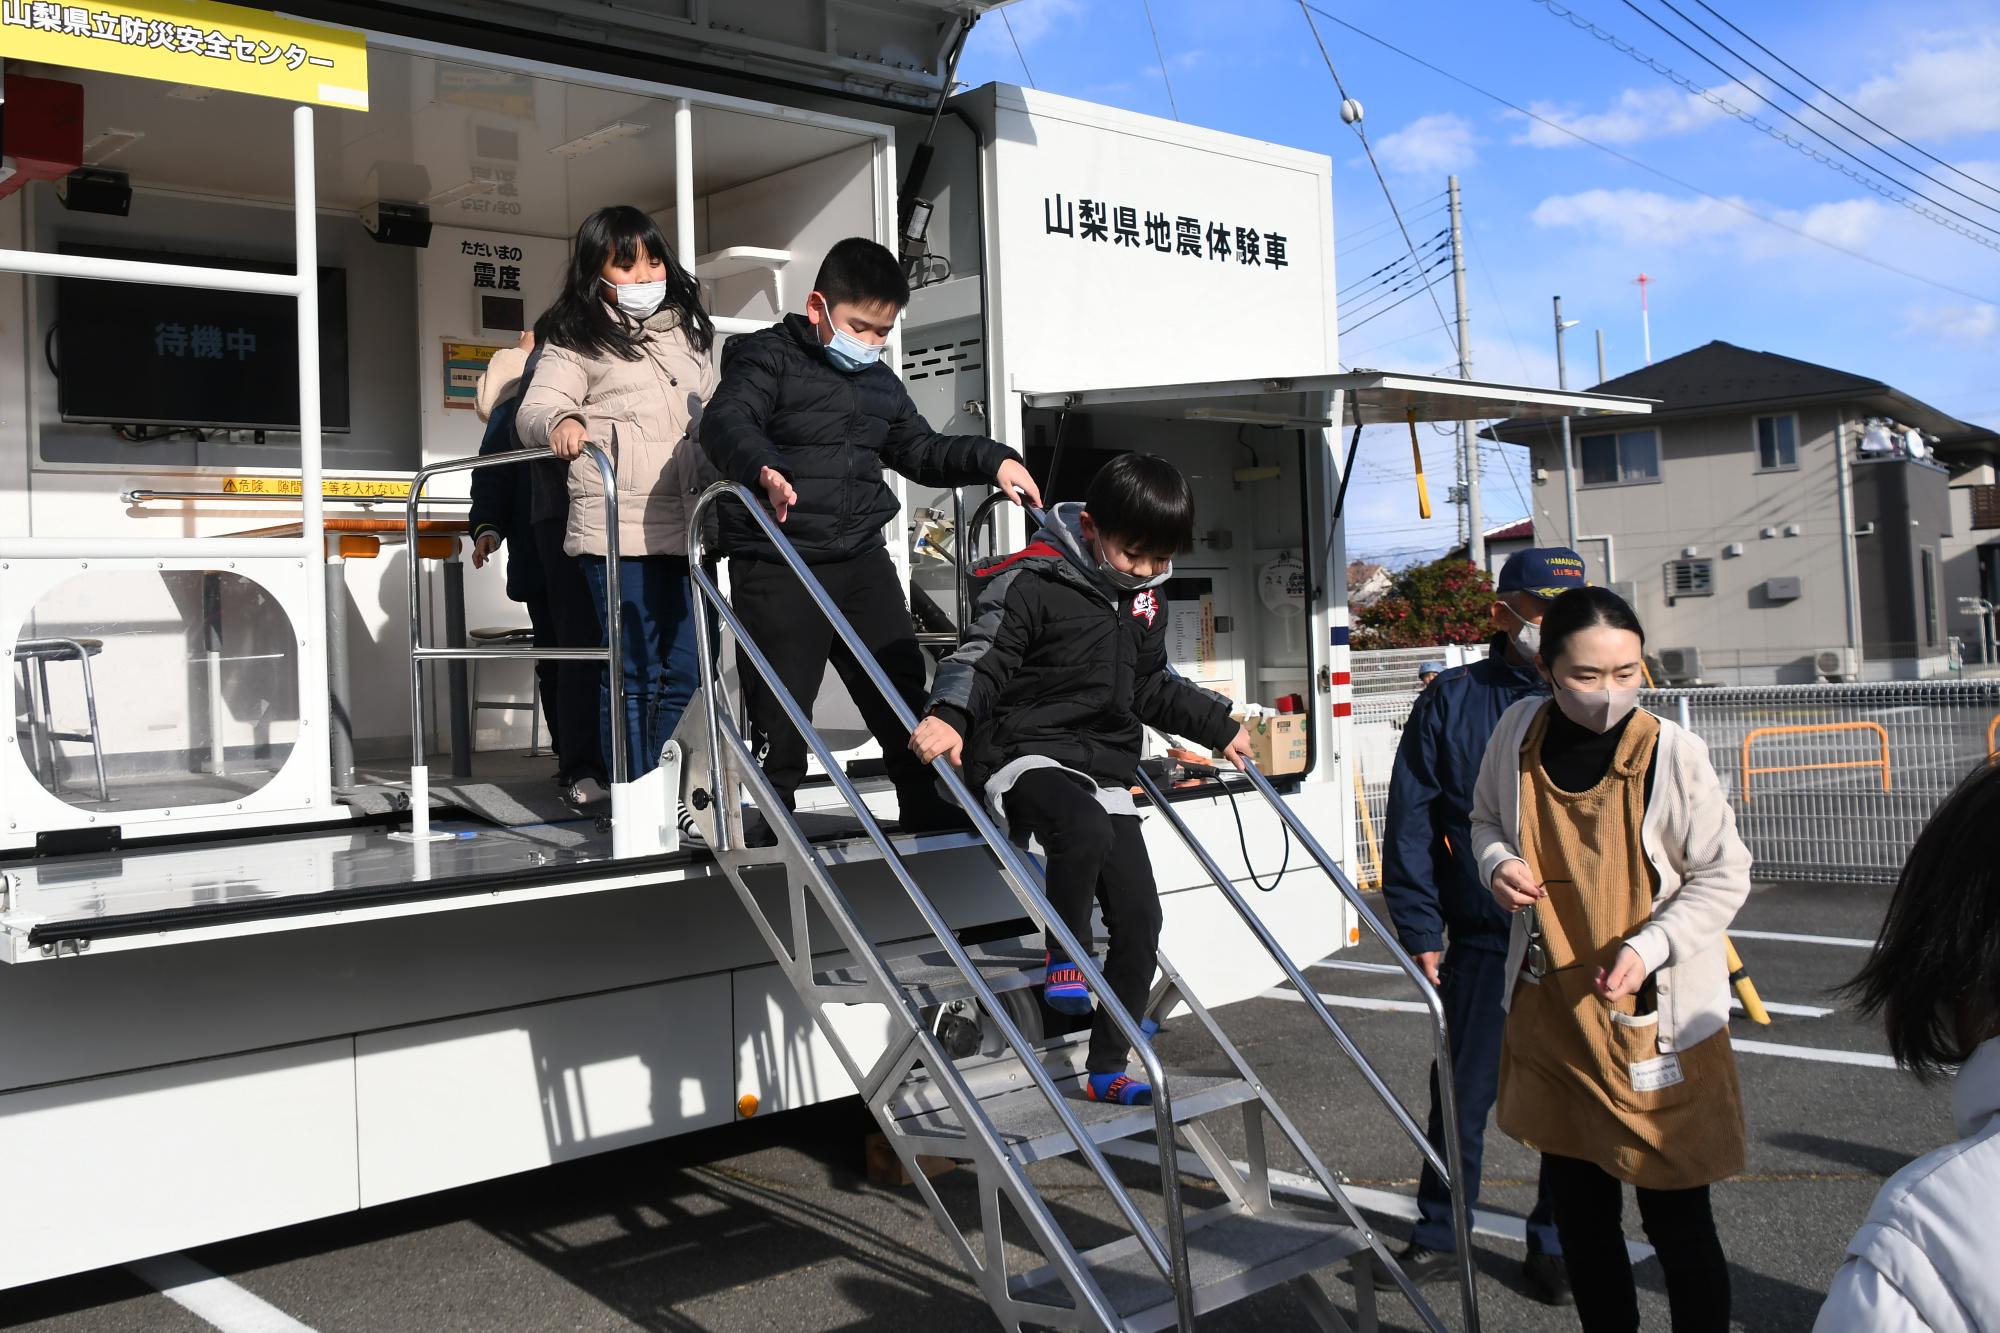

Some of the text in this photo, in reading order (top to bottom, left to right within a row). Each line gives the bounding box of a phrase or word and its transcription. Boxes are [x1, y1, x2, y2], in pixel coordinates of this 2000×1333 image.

[2, 0, 335, 71] 山梨県立防災安全センター
[461, 240, 523, 262] ただいまの
[1044, 193, 1290, 270] 山梨県地震体験車
[473, 261, 521, 291] 震度
[154, 322, 257, 361] 待機中
